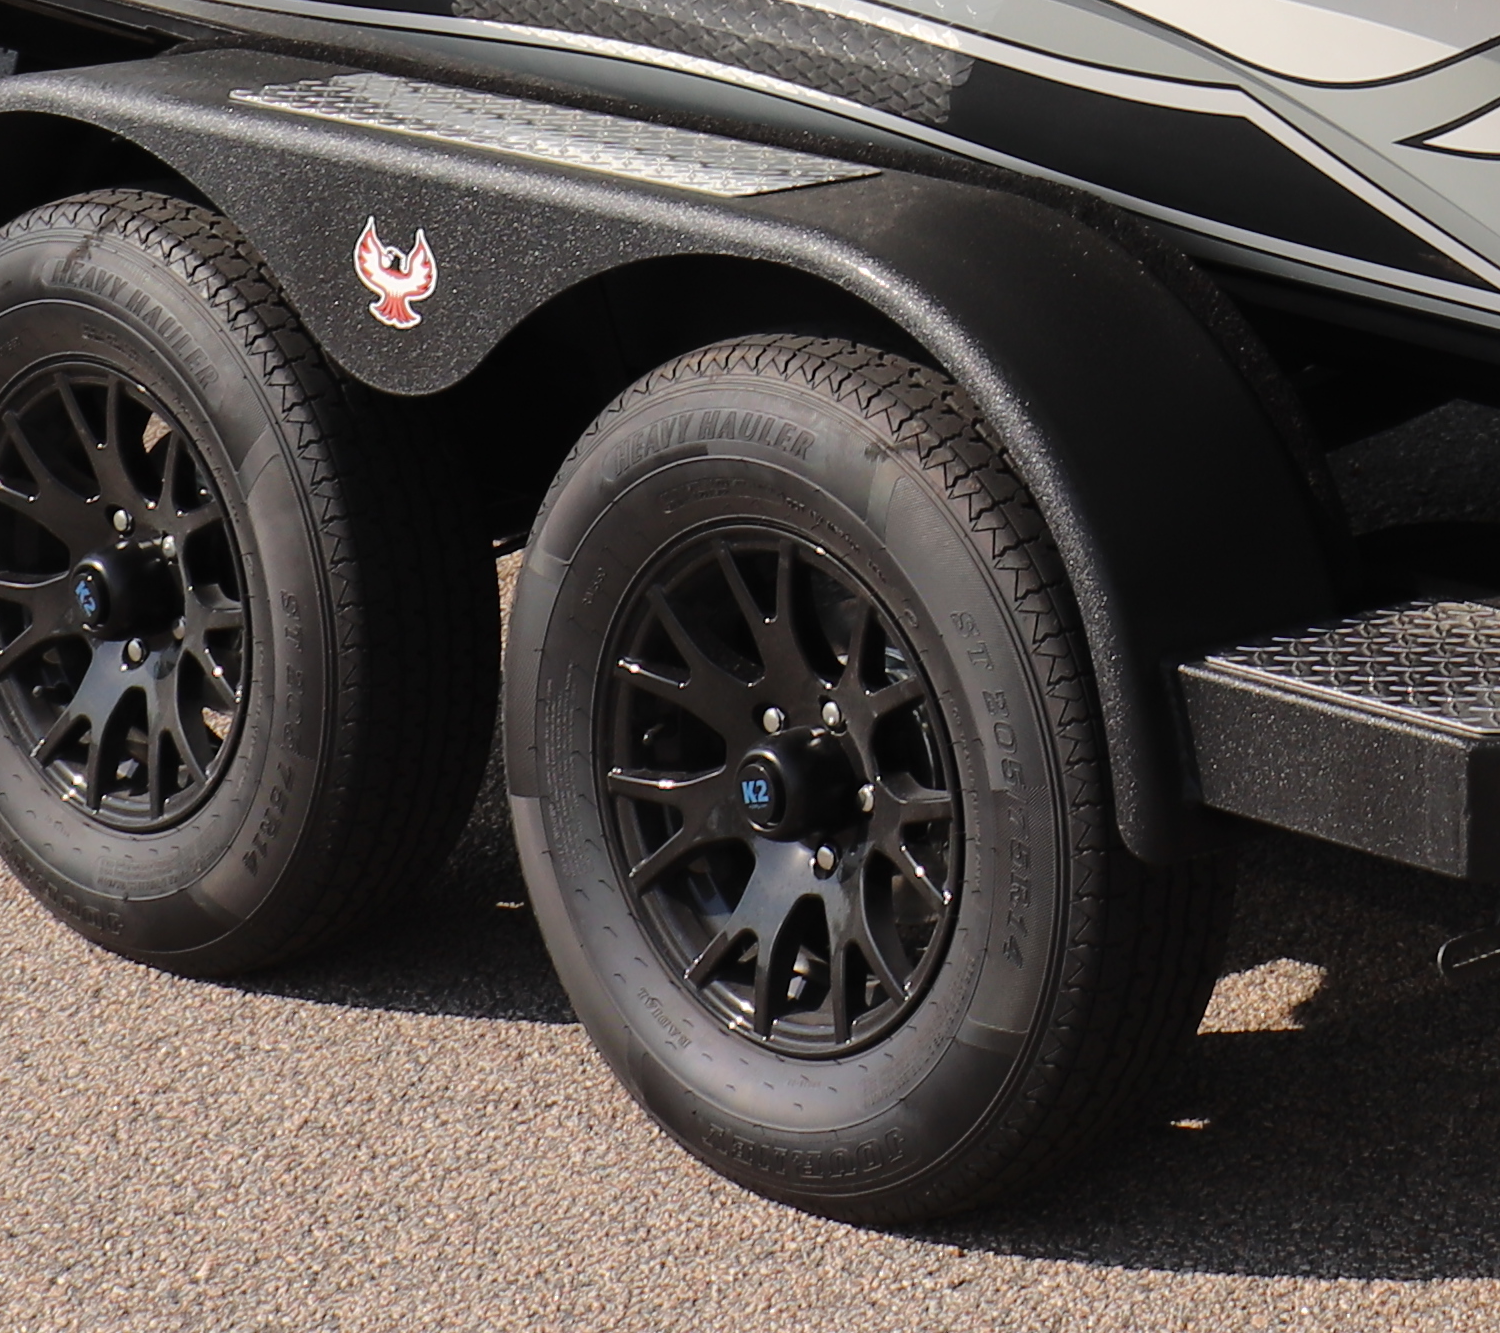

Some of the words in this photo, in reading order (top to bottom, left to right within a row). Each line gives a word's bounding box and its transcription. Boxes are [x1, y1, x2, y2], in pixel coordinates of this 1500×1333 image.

[51, 259, 129, 302] HEAVY
[126, 290, 219, 391] HAULER
[612, 410, 693, 479] HEAVY
[697, 409, 819, 461] HAULER
[75, 579, 97, 617] K2
[949, 611, 996, 671] ST
[741, 779, 770, 804] K2
[637, 986, 693, 1050] RADIAL
[700, 1123, 909, 1179] JOURNEY
